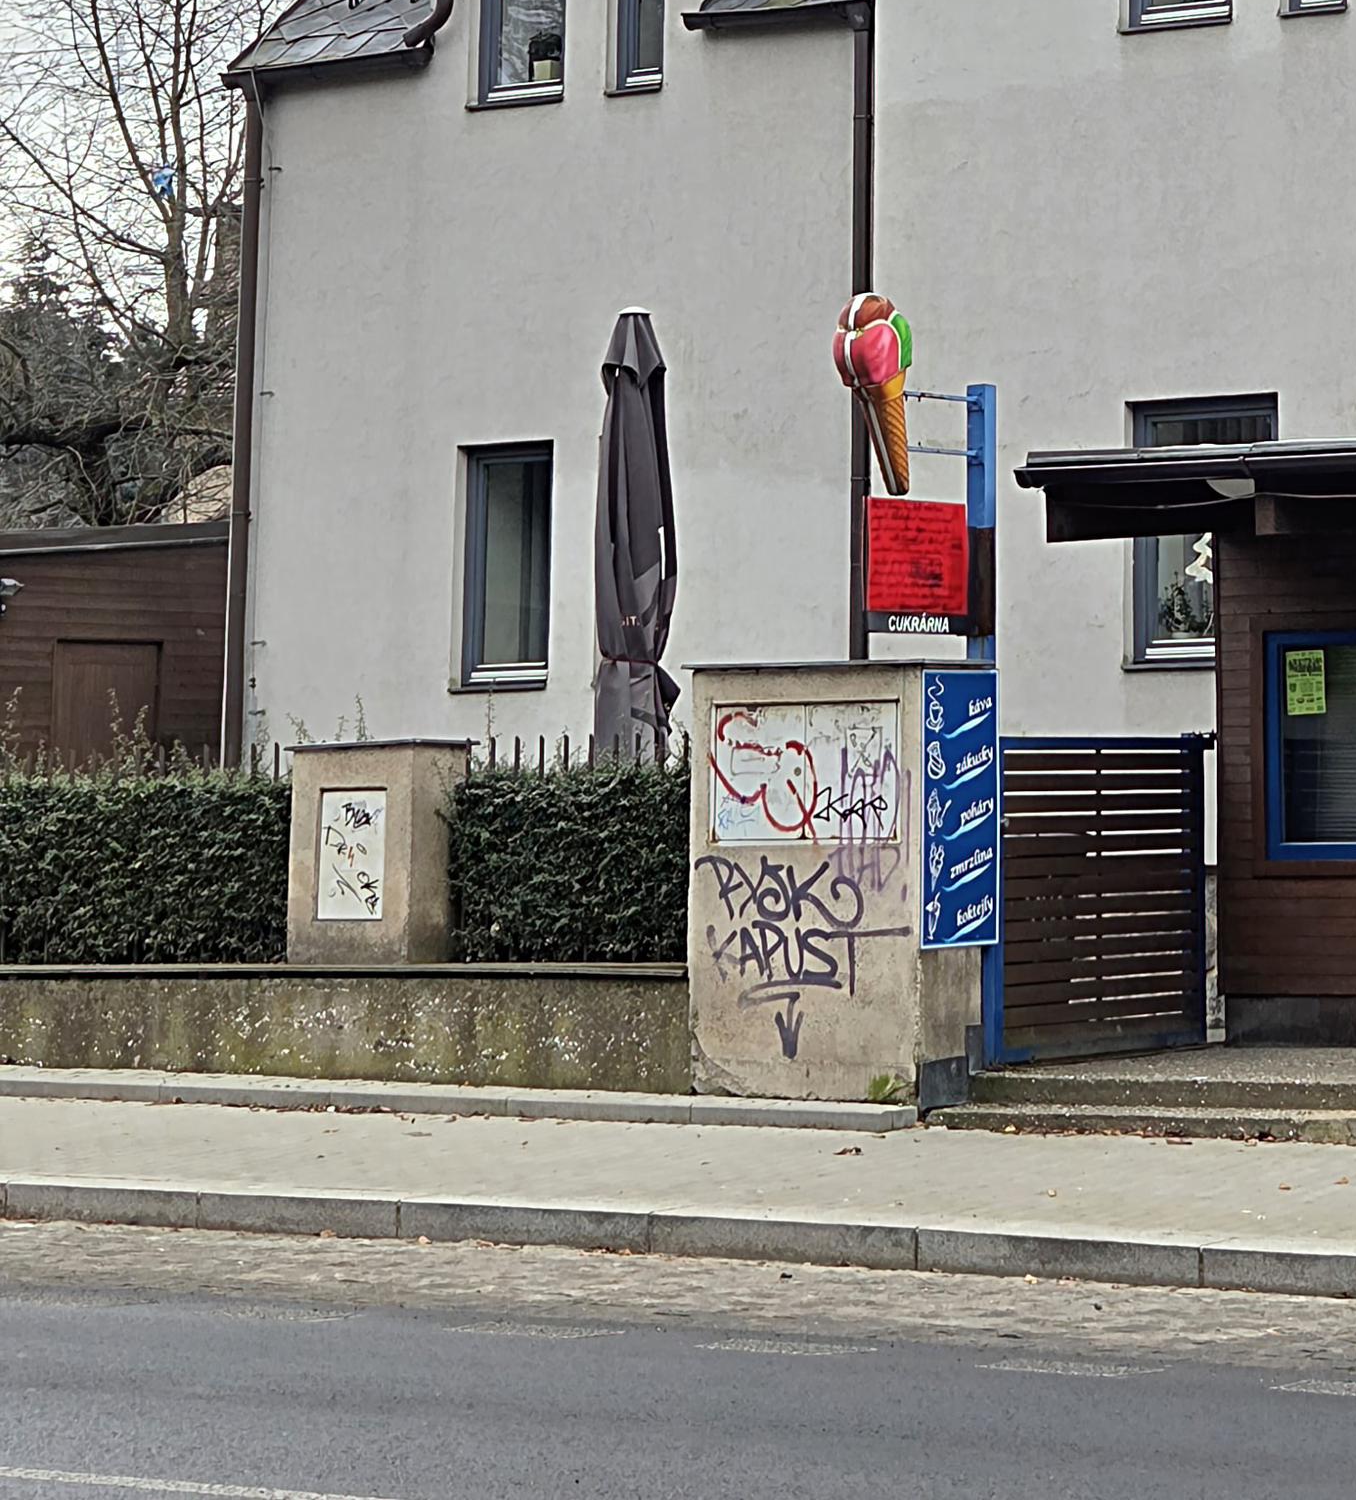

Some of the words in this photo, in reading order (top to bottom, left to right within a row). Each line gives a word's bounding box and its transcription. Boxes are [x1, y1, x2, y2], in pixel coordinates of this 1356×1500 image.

[888, 612, 950, 633] CUKRÁRNA
[968, 696, 993, 717] káva
[955, 744, 994, 776] zákusky
[960, 797, 994, 826] poháry
[950, 846, 994, 879] zmrzlina
[956, 894, 994, 927] koktejly
